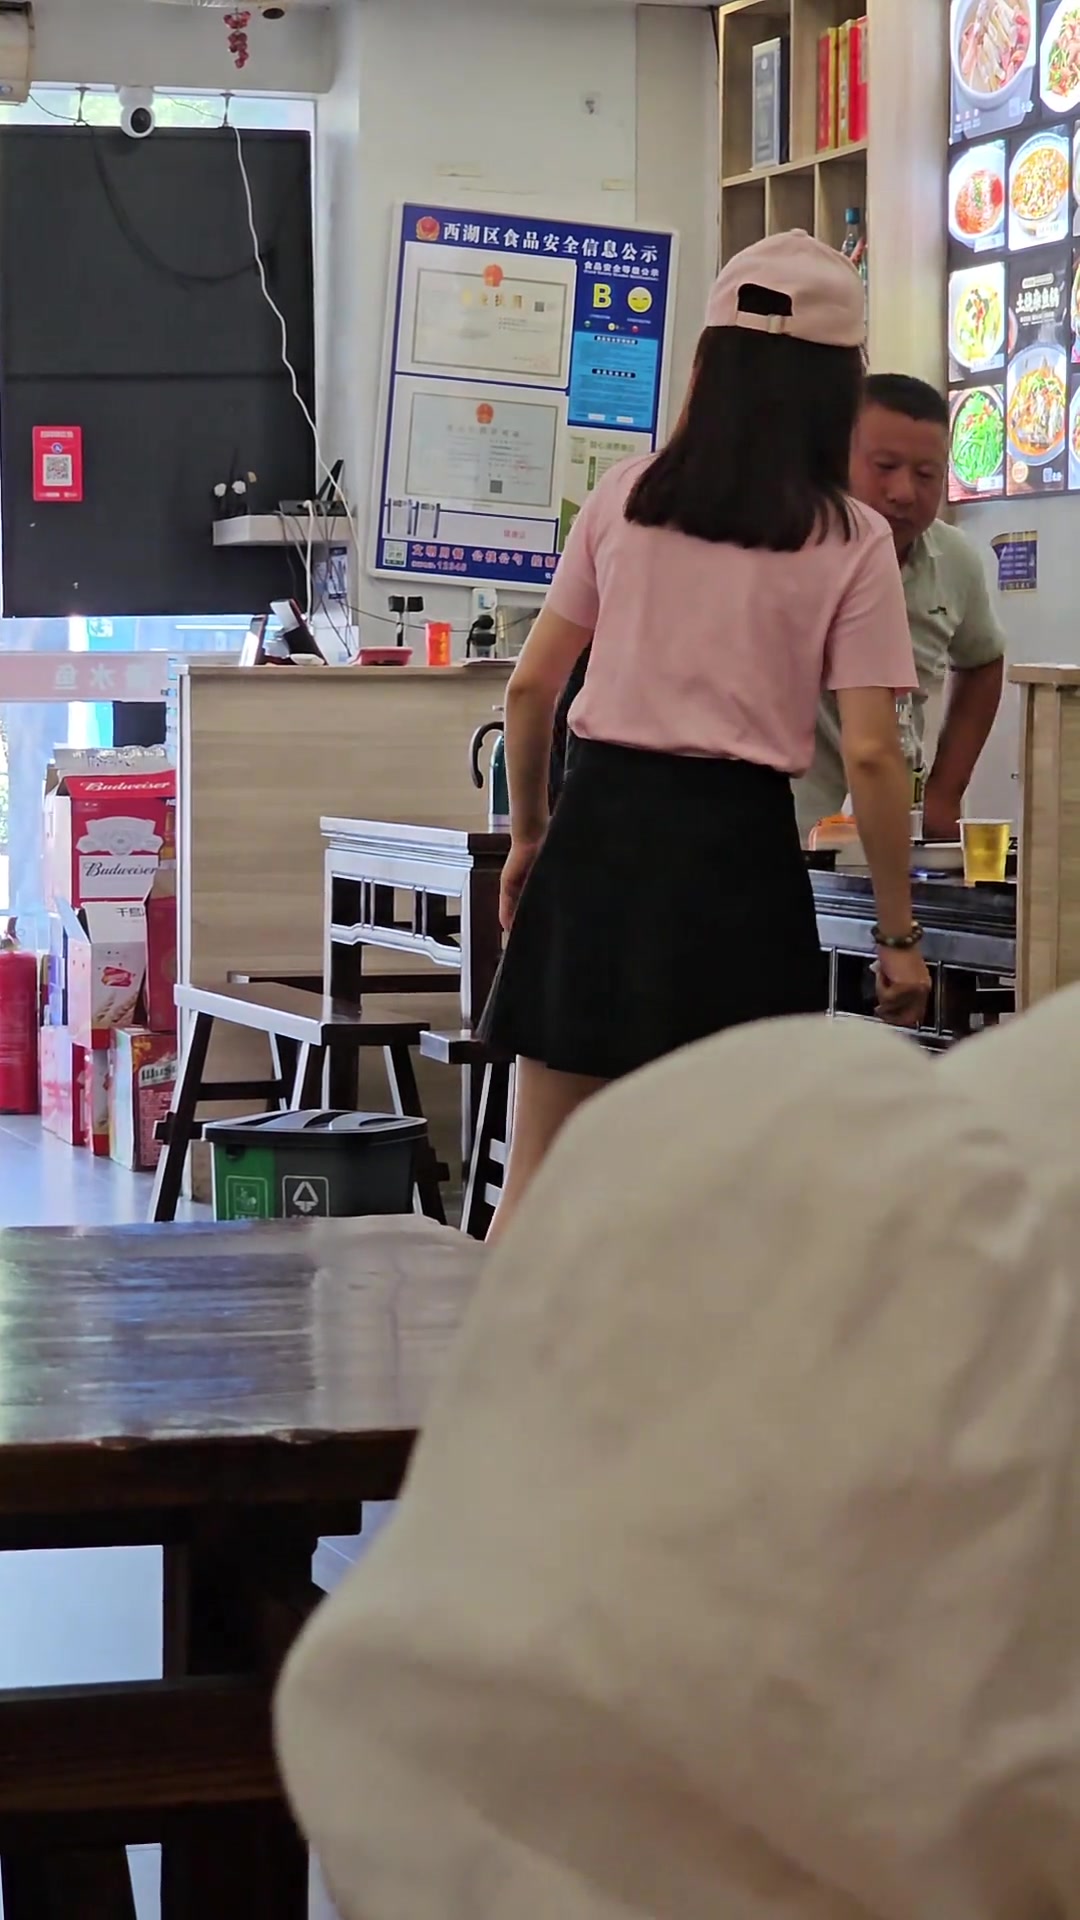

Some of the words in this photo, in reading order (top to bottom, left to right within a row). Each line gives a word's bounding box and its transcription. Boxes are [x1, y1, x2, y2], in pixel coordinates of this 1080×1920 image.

[443, 222, 659, 263] 西湖区食品安全信息公示
[592, 282, 612, 308] B
[80, 779, 170, 792] Budweiser
[83, 861, 158, 878] Budweiser
